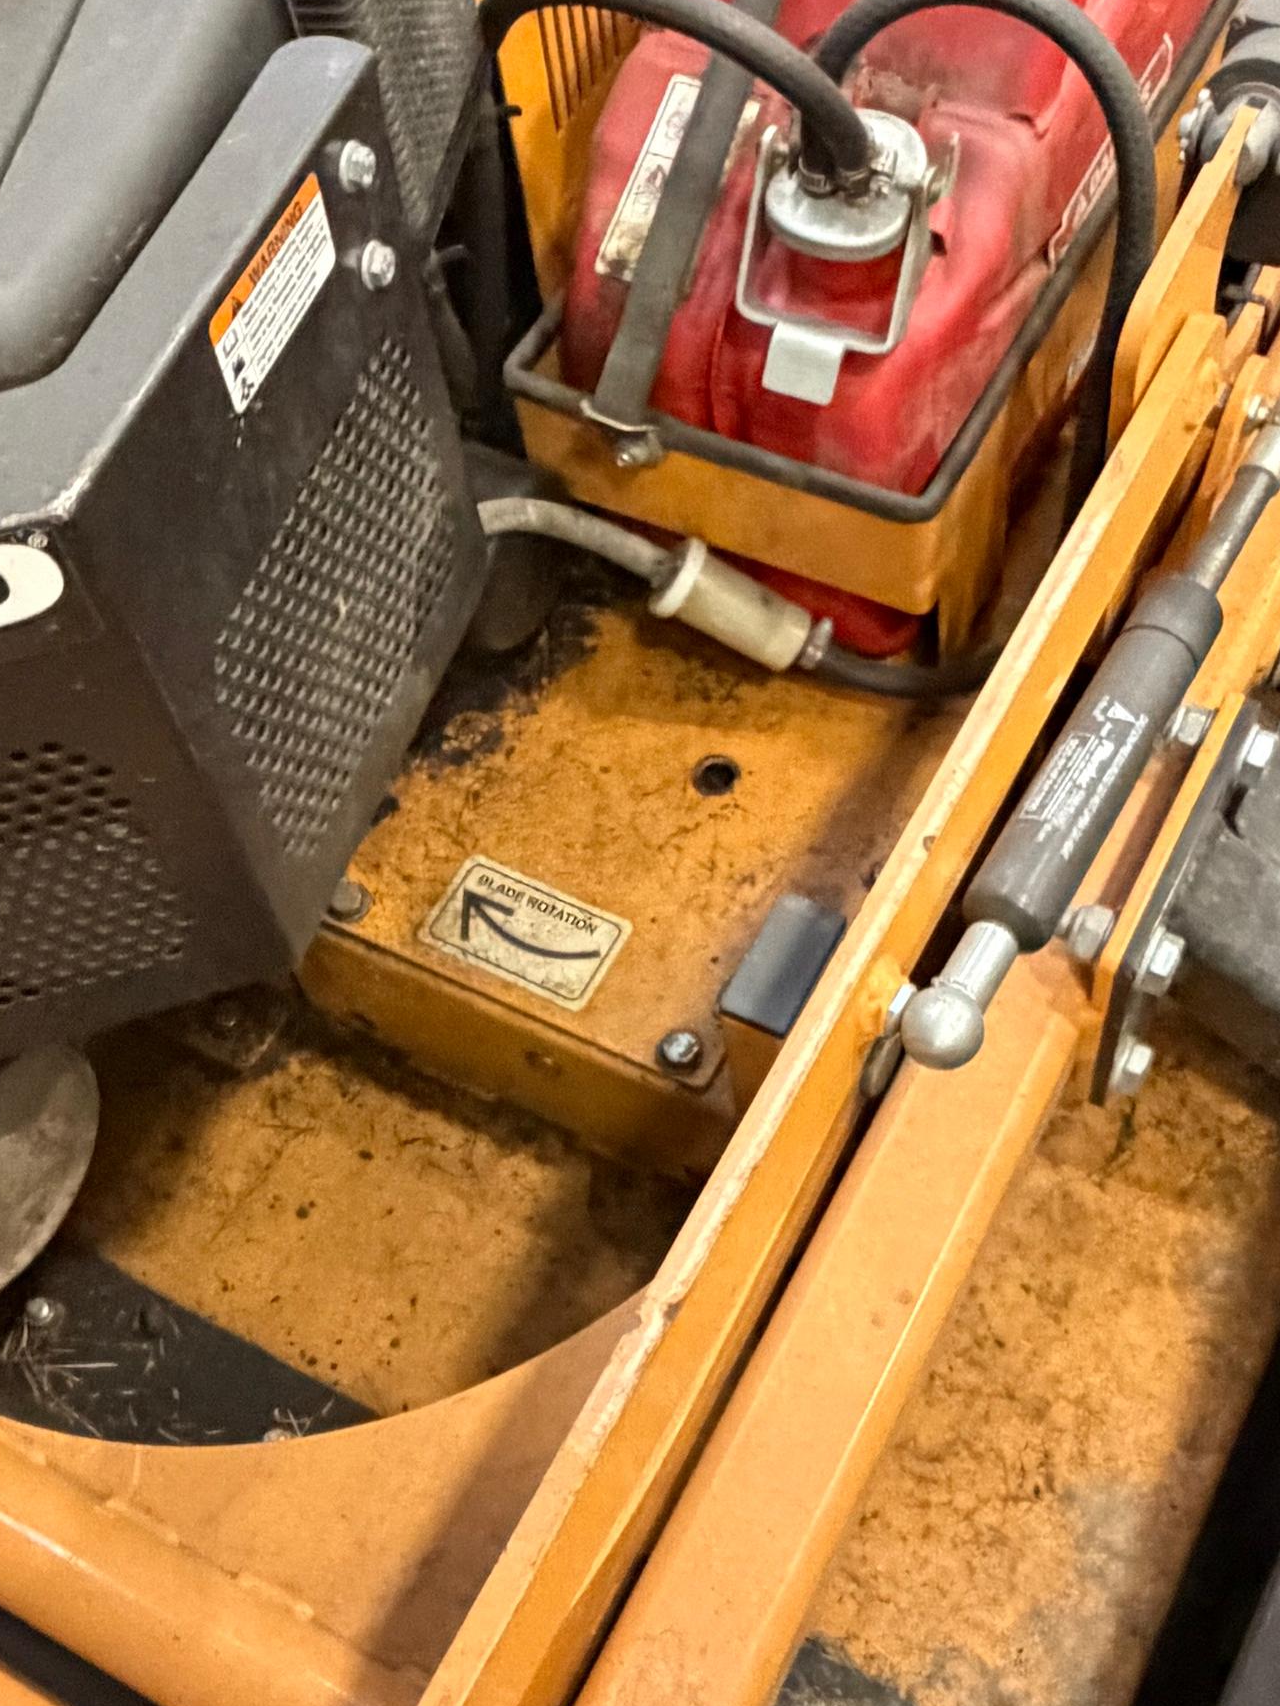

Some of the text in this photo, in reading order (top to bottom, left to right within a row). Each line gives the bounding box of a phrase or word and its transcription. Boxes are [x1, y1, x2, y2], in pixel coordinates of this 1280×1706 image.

[248, 200, 304, 287] WARNING
[477, 873, 598, 936] BLADE ROTATION
